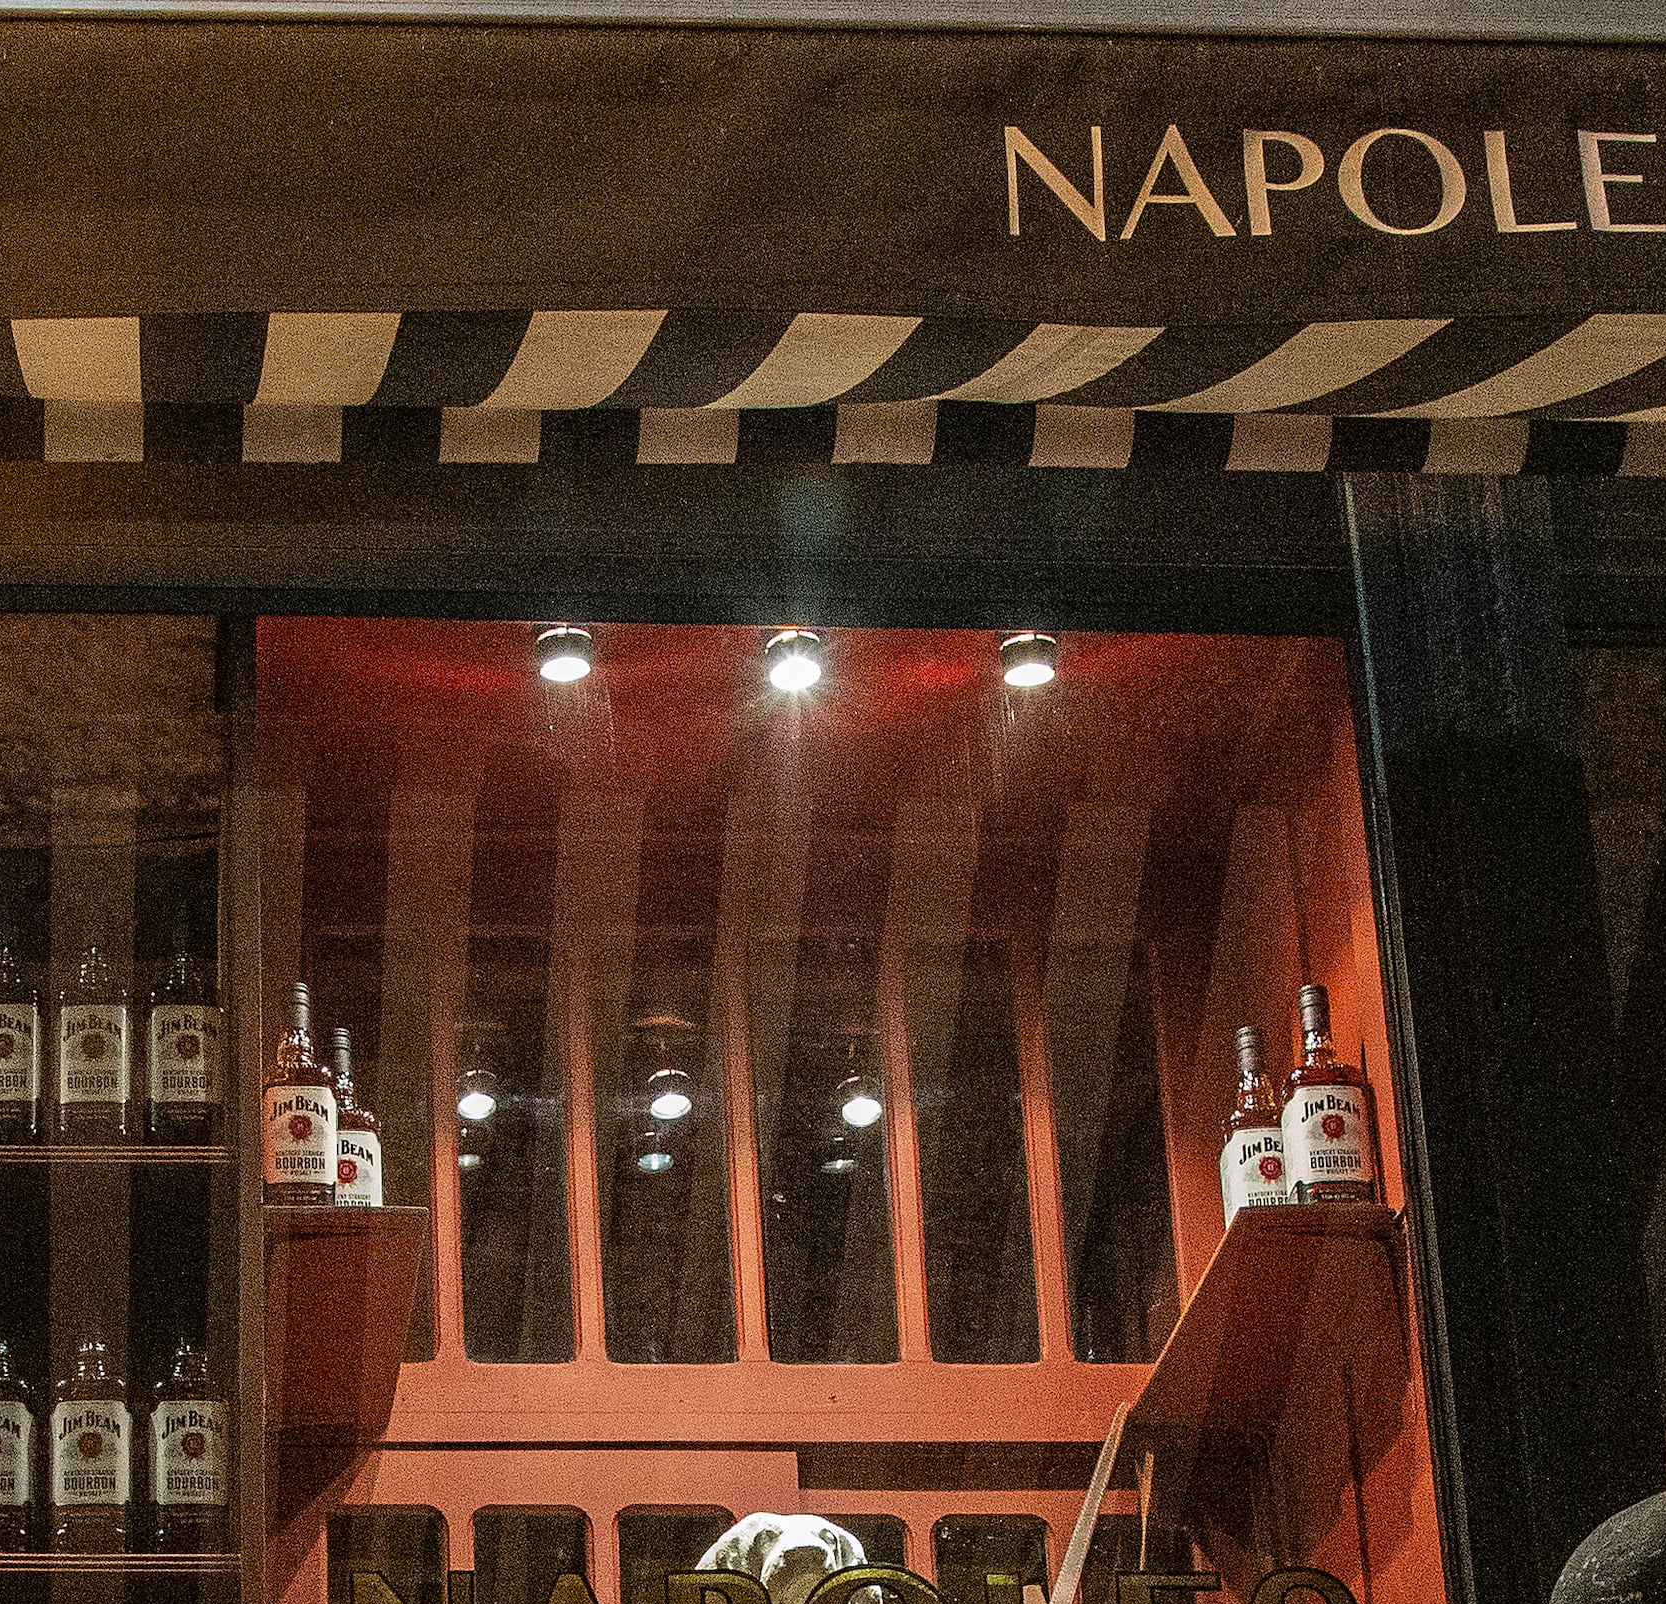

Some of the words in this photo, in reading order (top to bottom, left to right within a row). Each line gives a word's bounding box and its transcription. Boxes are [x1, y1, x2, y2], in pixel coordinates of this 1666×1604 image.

[270, 1099, 294, 1120] JIM
[295, 1095, 329, 1122] BEAM
[1301, 1101, 1324, 1123] JIM
[1326, 1094, 1361, 1119] BEAM
[275, 1157, 325, 1170] BOURBON
[342, 1139, 374, 1166] BEAM
[1239, 1141, 1262, 1165] JIM
[1264, 1136, 1284, 1153] BE
[1311, 1155, 1362, 1169] BOURBON
[58, 1418, 83, 1441] JIM
[85, 1410, 121, 1439] BEAM
[161, 1416, 186, 1440] JIM
[64, 1477, 116, 1490] BOURBON
